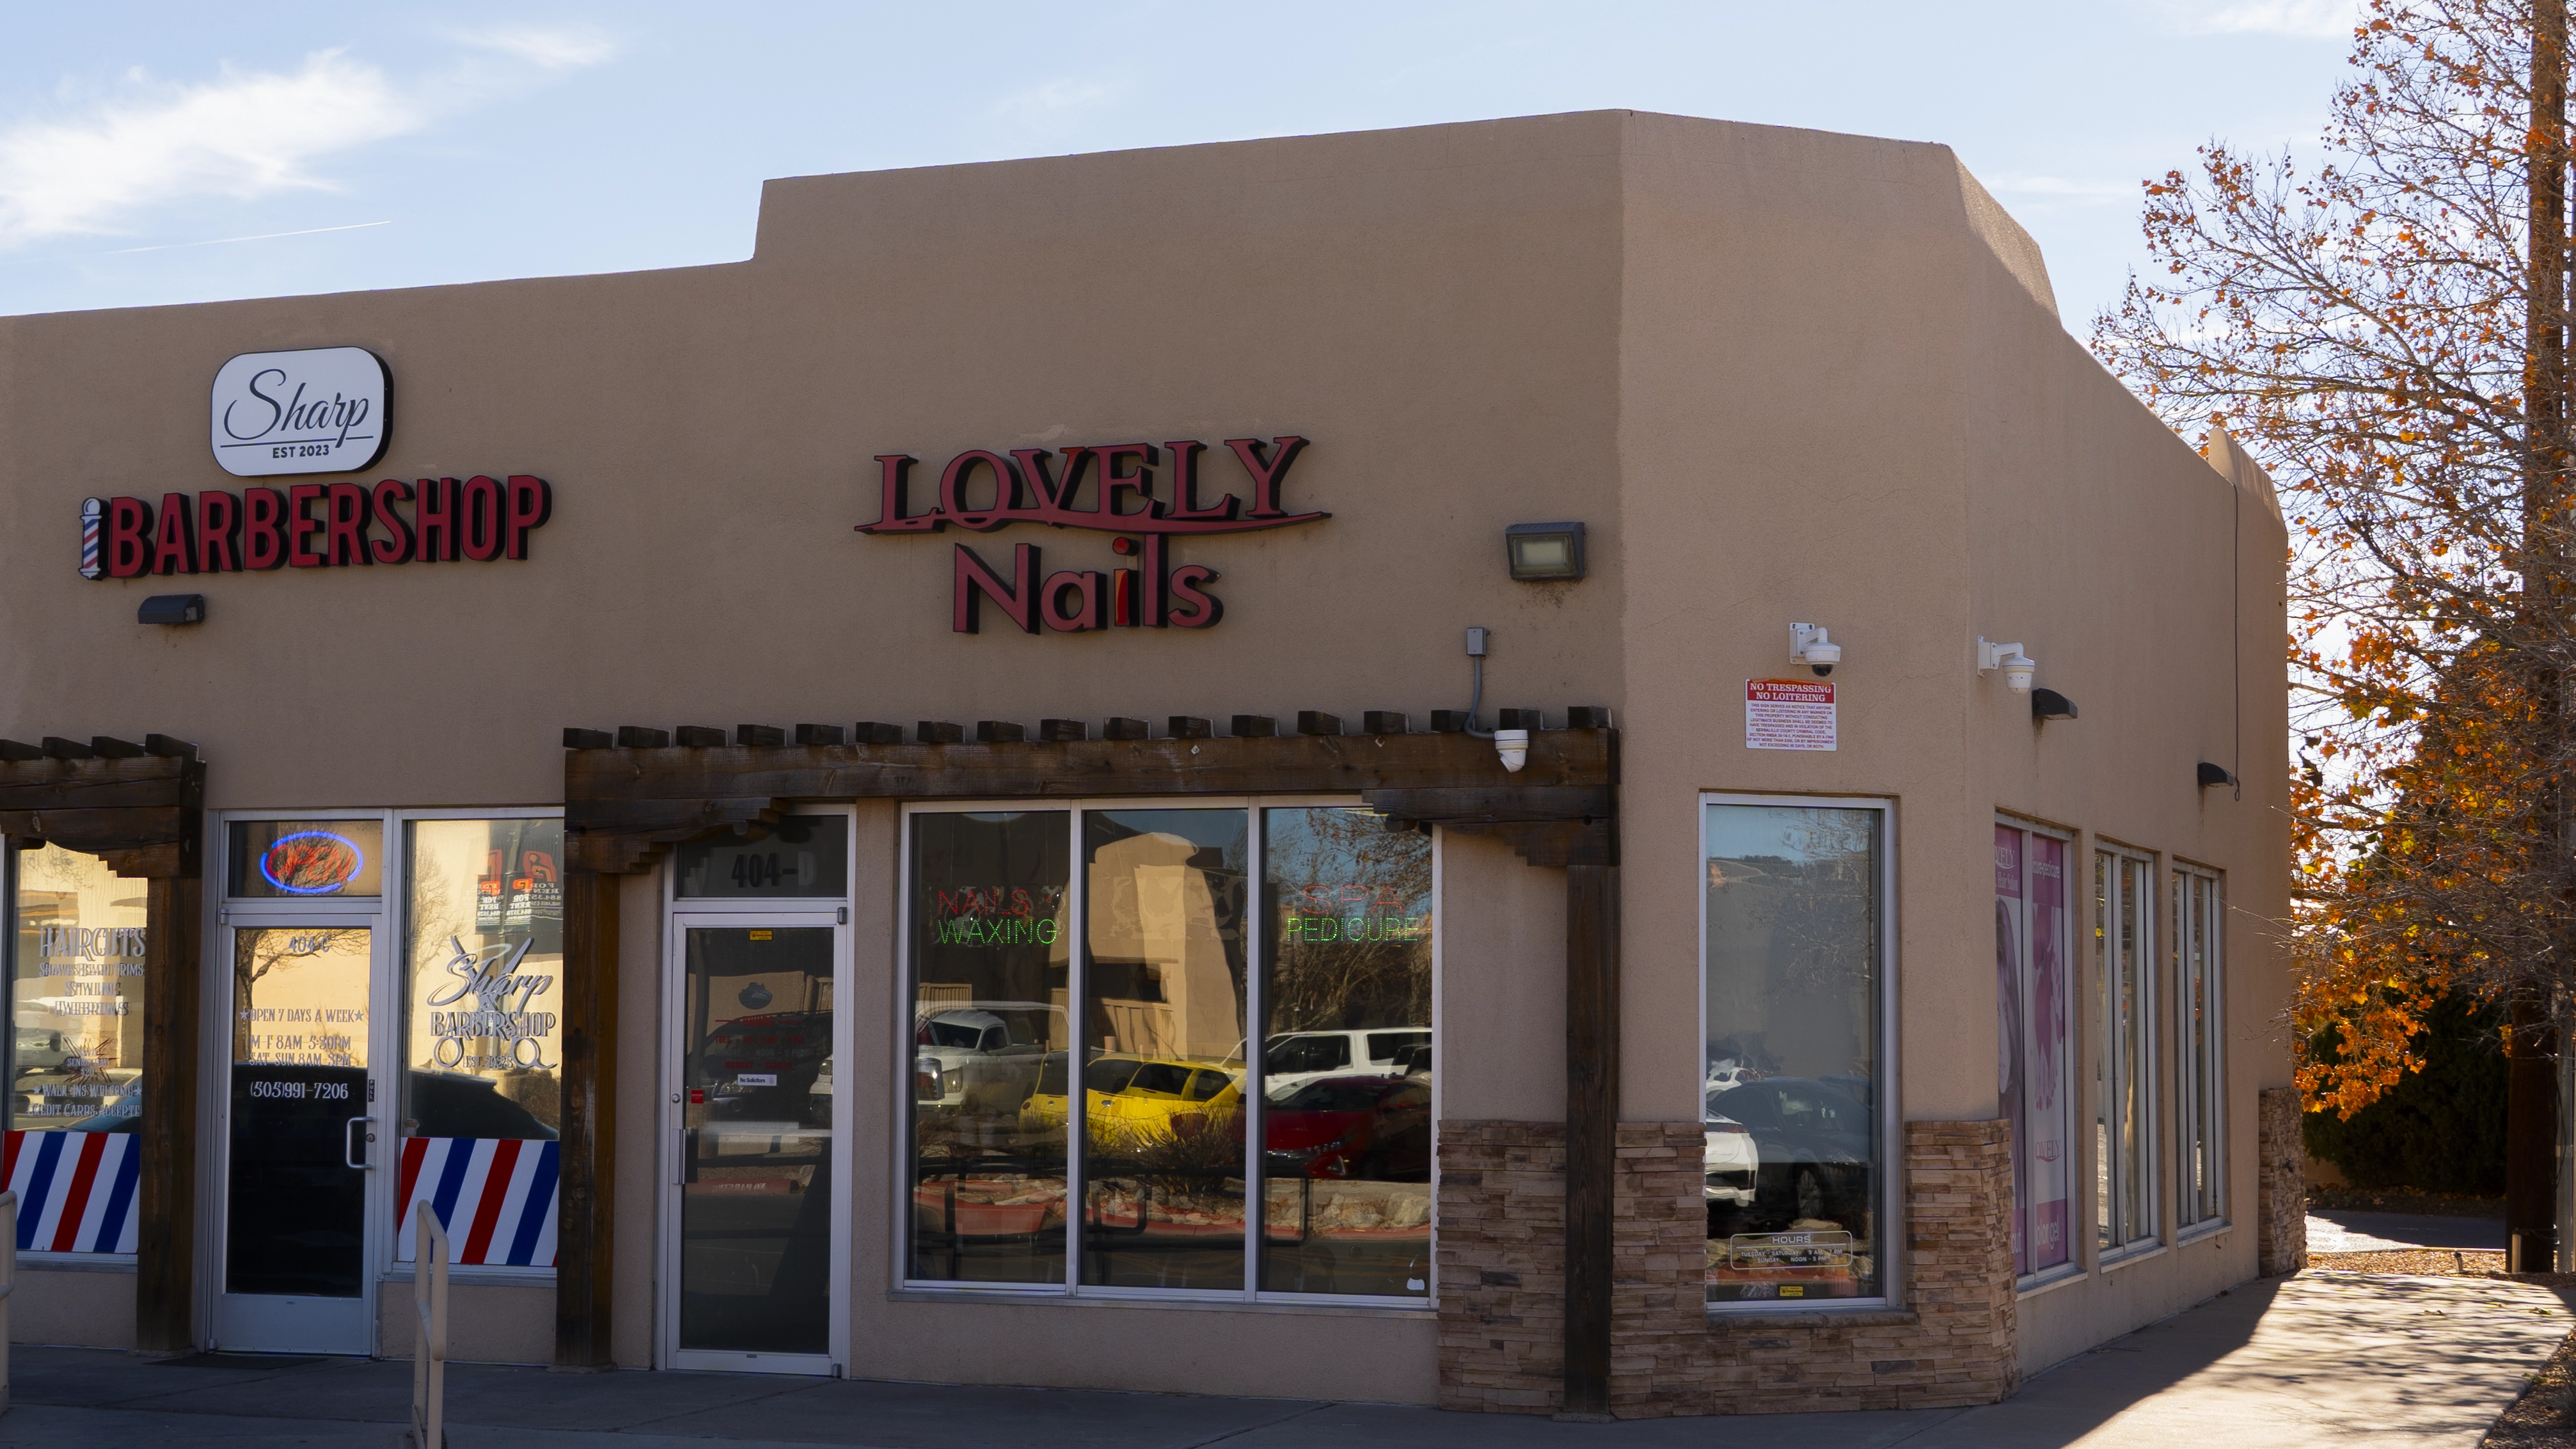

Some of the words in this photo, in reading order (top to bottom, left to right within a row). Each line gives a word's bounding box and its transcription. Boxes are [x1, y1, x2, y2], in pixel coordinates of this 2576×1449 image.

[223, 368, 370, 448] Sharp
[273, 445, 296, 459] EST
[299, 443, 330, 459] 2023
[855, 436, 1332, 534] LOVELY
[110, 475, 552, 579] BARBERSHOP
[952, 534, 1224, 635] Nails
[1750, 683, 1764, 691] NO
[1766, 684, 1831, 693] TRESPASSING
[1773, 693, 1826, 702] LOITERING
[266, 844, 354, 882] OPEN
[731, 851, 818, 888] 404-D
[938, 889, 1029, 915] NAILS
[1302, 884, 1405, 914] SPA
[938, 919, 1057, 944] WAXING
[1287, 917, 1419, 942] PEDICURE
[39, 927, 146, 962] HAIRCUTS
[427, 952, 554, 1019] Sharp
[249, 1008, 276, 1022] OPEN
[278, 1009, 285, 1022] 7
[287, 1008, 312, 1022] DAYS
[314, 1009, 322, 1022] A
[326, 1009, 354, 1022] WEEK
[430, 1011, 557, 1041] BARBERSHOP
[250, 1034, 273, 1050] M-F
[81, 1067, 95, 1076] $20
[250, 1081, 349, 1100] (505)991-7206
[27, 1104, 62, 1118] CREDIT
[63, 1104, 95, 1117] CARDS
[99, 1104, 142, 1118] ACCEPTE
[1773, 1235, 1811, 1244] HOURS
[2050, 1214, 2060, 1251] gel
